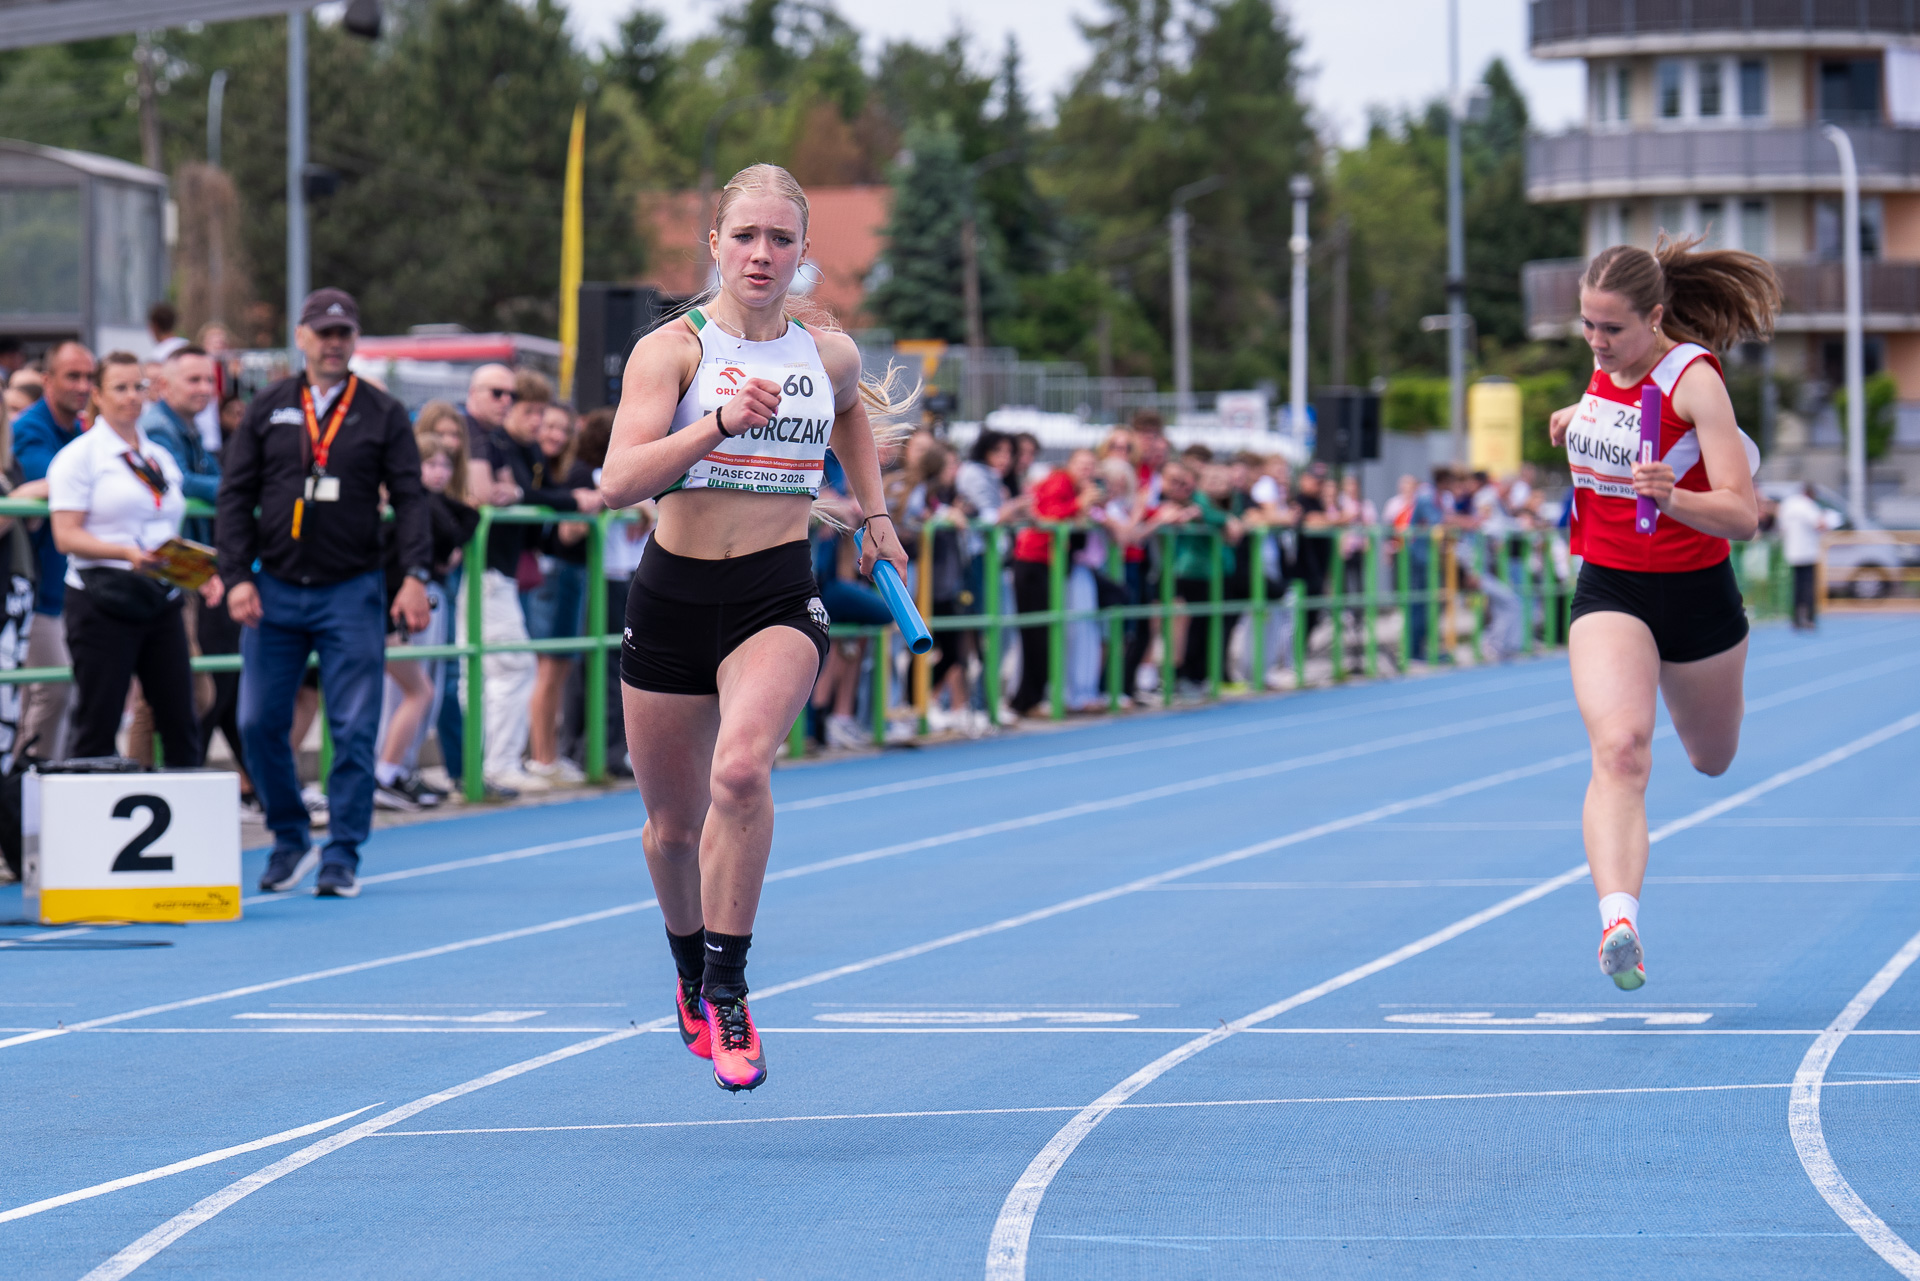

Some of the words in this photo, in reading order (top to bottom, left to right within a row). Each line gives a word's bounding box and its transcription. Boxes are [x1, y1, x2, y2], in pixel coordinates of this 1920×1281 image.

[783, 374, 813, 397] 60
[1569, 432, 1639, 466] KULIŃSK
[711, 466, 777, 481] PIASECZNO
[780, 474, 805, 484] 2026
[111, 794, 174, 872] 2
